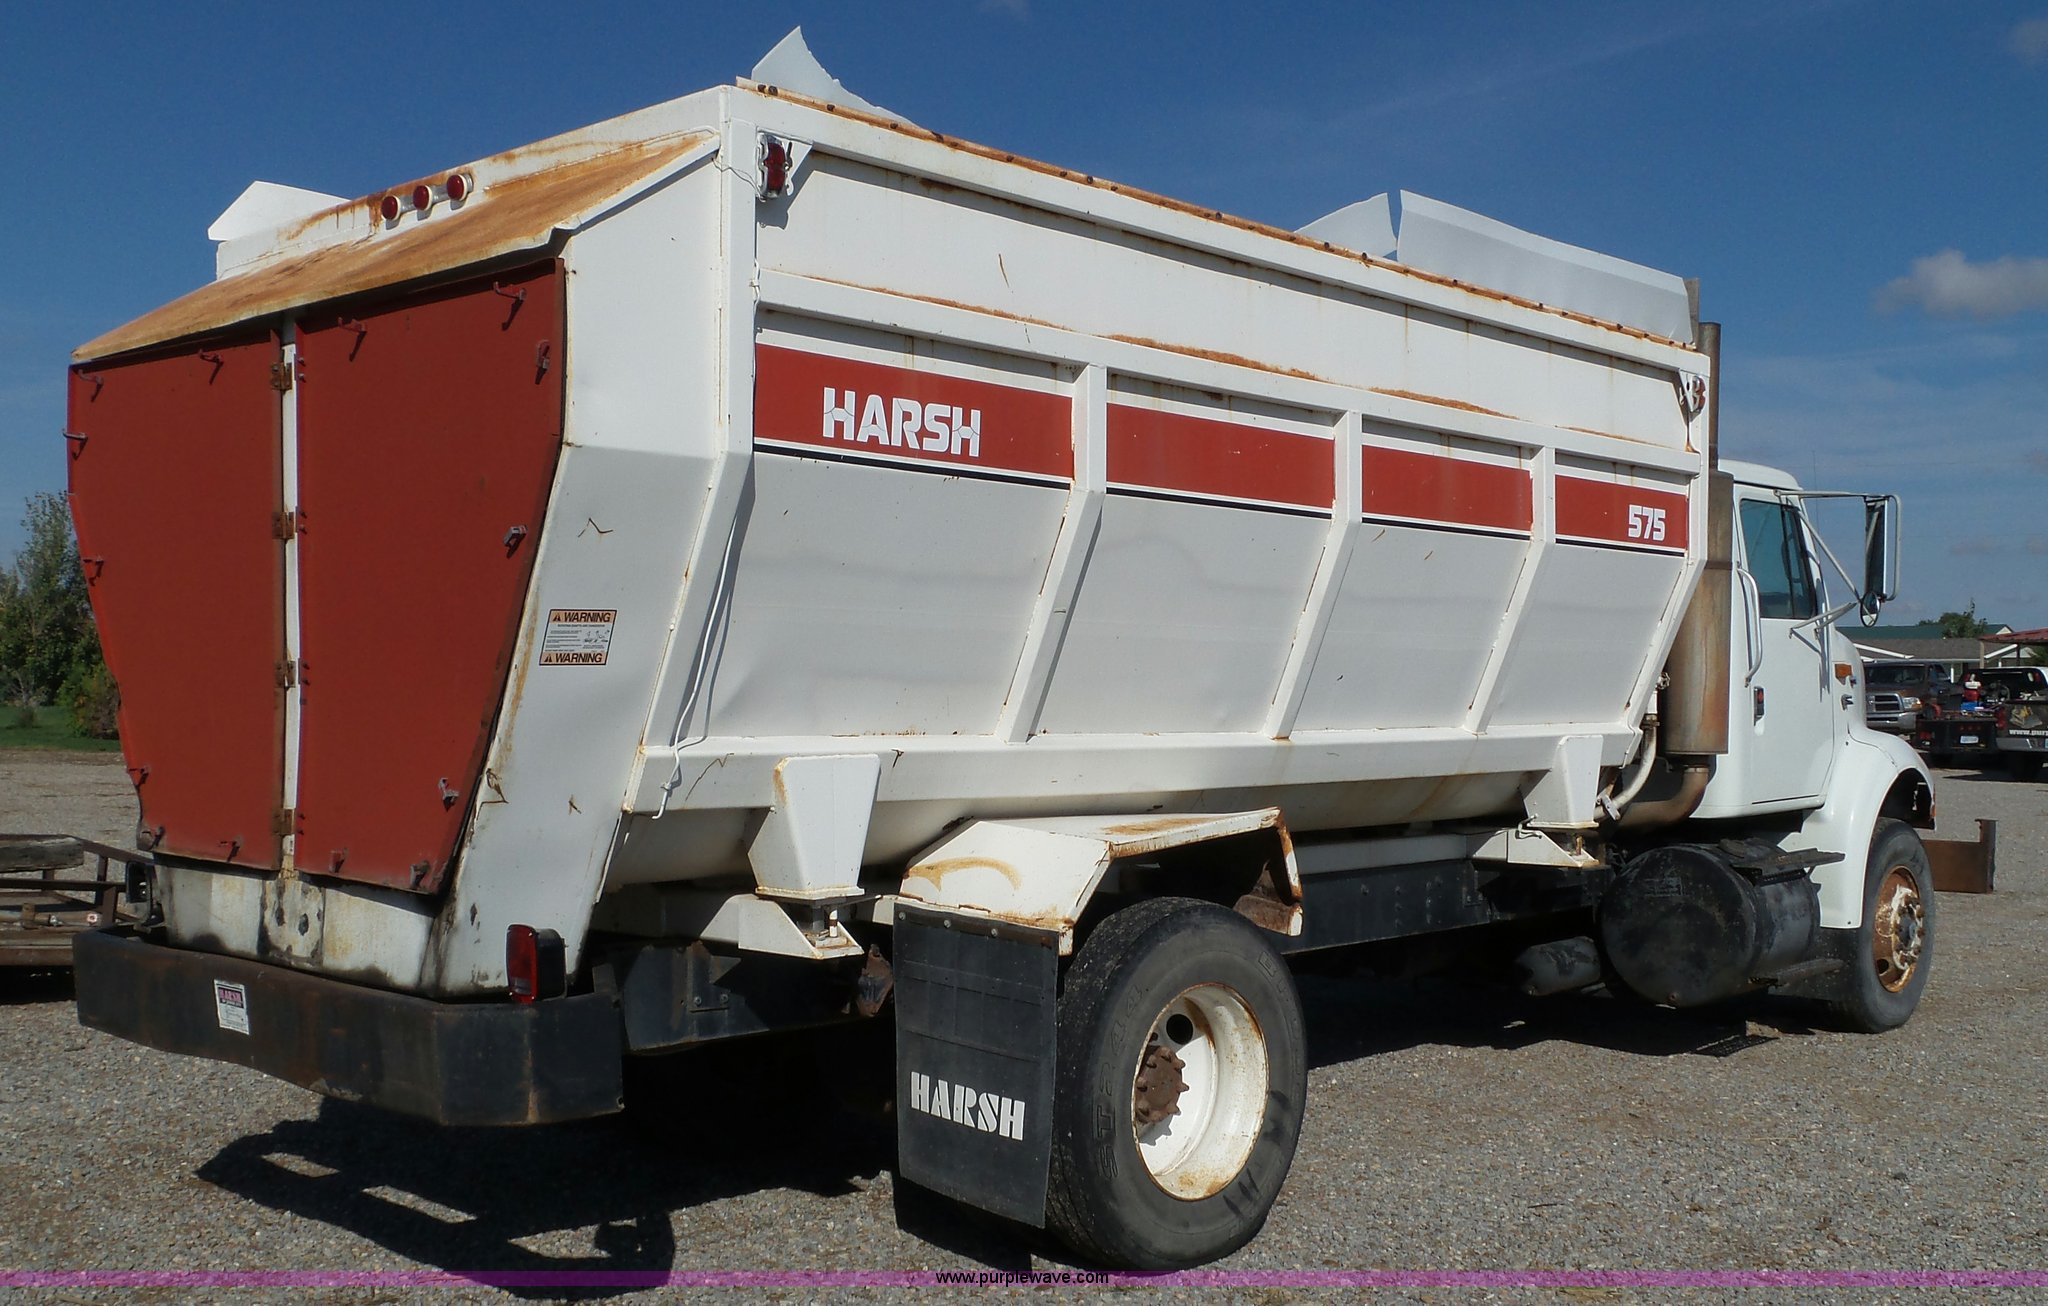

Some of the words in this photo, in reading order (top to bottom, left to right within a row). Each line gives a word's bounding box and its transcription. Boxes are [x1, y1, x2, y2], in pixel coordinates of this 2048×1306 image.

[823, 386, 981, 457] HARSH
[1628, 504, 1666, 541] 575
[564, 612, 611, 622] WARNING
[555, 653, 603, 663] WARNING
[910, 1071, 1025, 1141] HARSH
